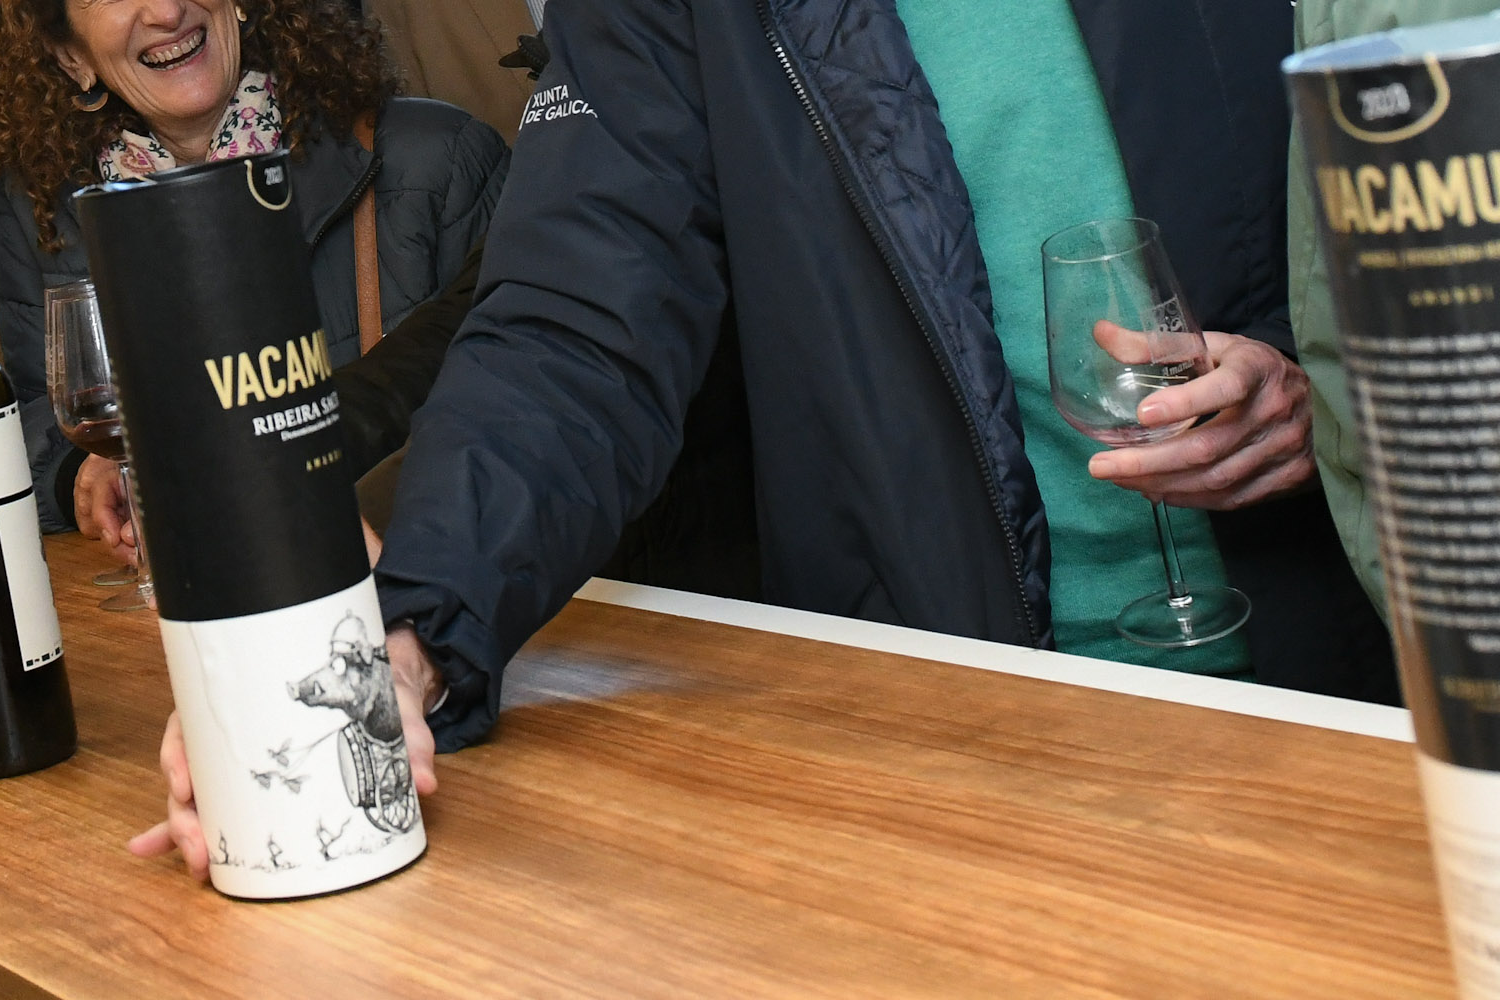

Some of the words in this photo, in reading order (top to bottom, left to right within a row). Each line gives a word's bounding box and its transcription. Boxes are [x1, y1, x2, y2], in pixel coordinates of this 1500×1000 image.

[532, 85, 569, 108] XUNTA
[526, 109, 545, 124] DE
[252, 402, 321, 436] RIBEIRA
